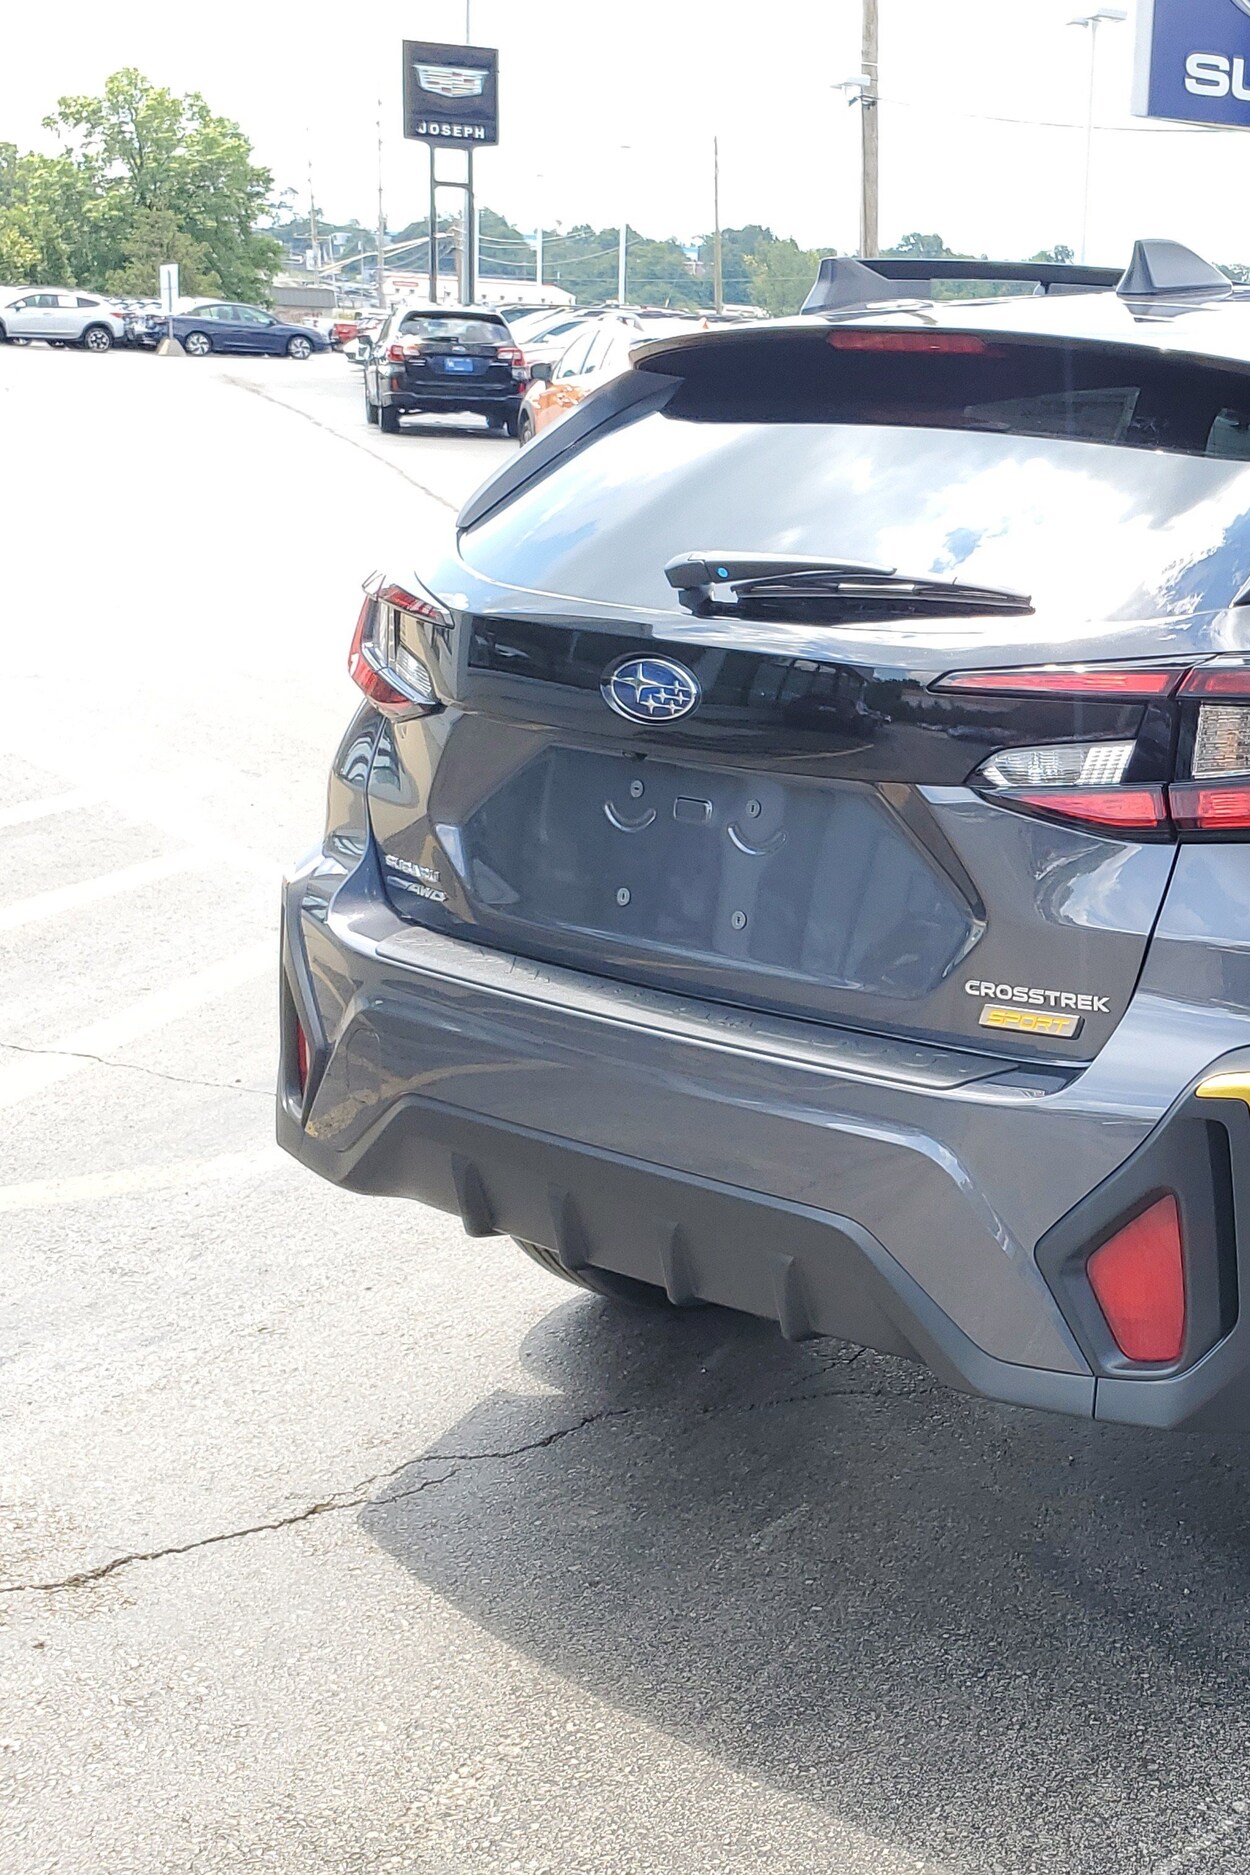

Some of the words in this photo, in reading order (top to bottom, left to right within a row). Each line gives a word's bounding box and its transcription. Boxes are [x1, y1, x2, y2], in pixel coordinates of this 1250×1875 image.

[416, 121, 486, 139] JOSEPH
[407, 883, 448, 902] AWD
[964, 980, 1110, 1013] CROSSTREK
[987, 1009, 1071, 1034] SPORT
